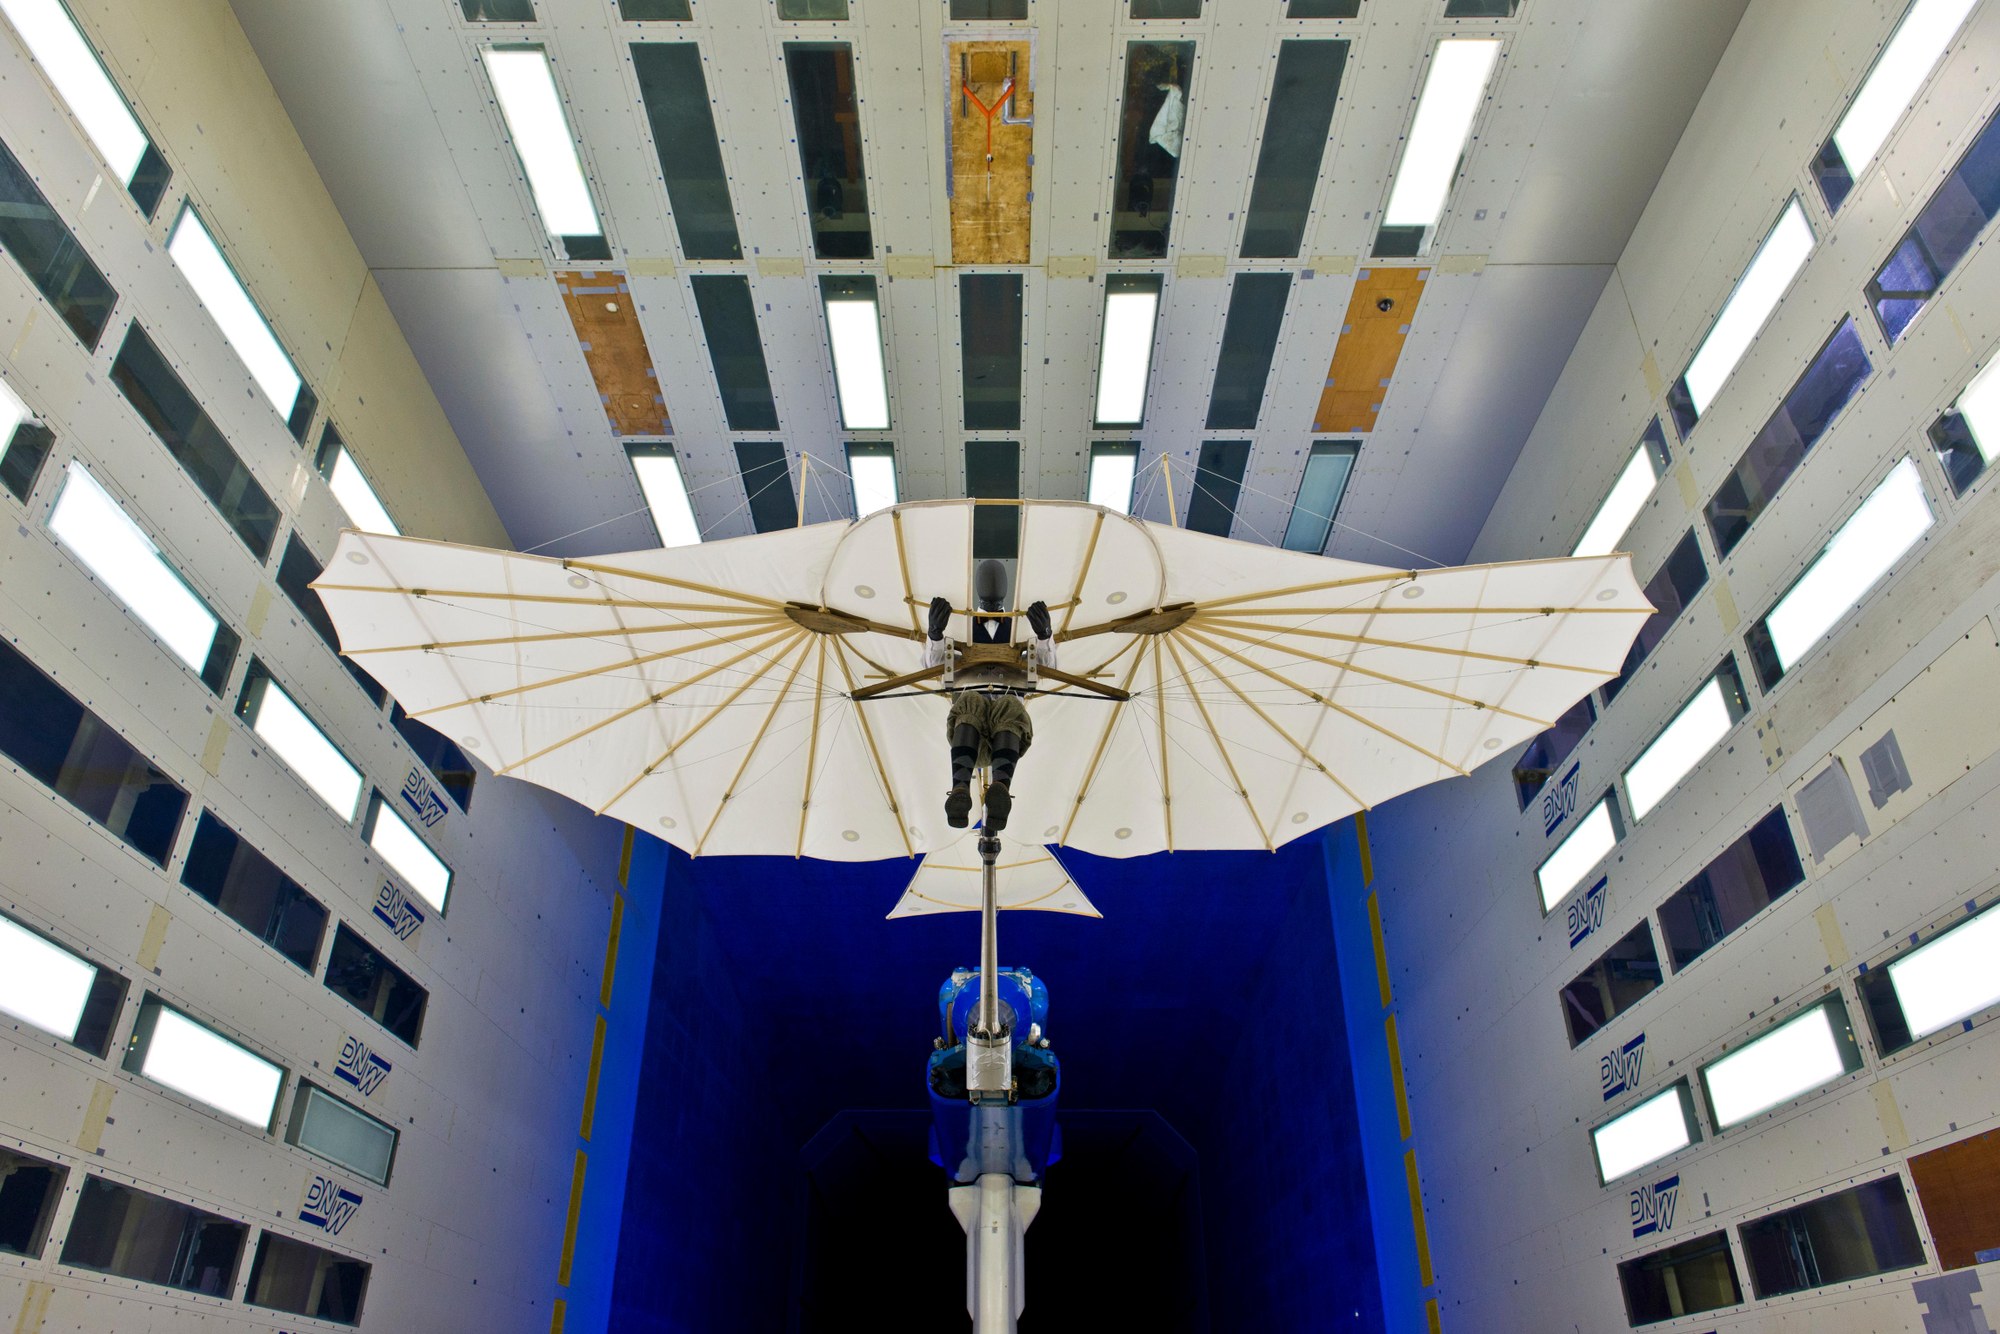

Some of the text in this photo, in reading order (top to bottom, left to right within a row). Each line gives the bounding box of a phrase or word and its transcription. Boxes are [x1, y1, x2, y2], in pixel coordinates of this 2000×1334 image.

[401, 767, 448, 828] DNW
[1543, 761, 1580, 838] DNW
[373, 880, 425, 941] DNW
[1568, 875, 1608, 949] DNW
[334, 1036, 392, 1096] DNW
[1601, 1032, 1646, 1102] DNW
[299, 1176, 363, 1236] DNW
[1630, 1176, 1680, 1239] DNW
